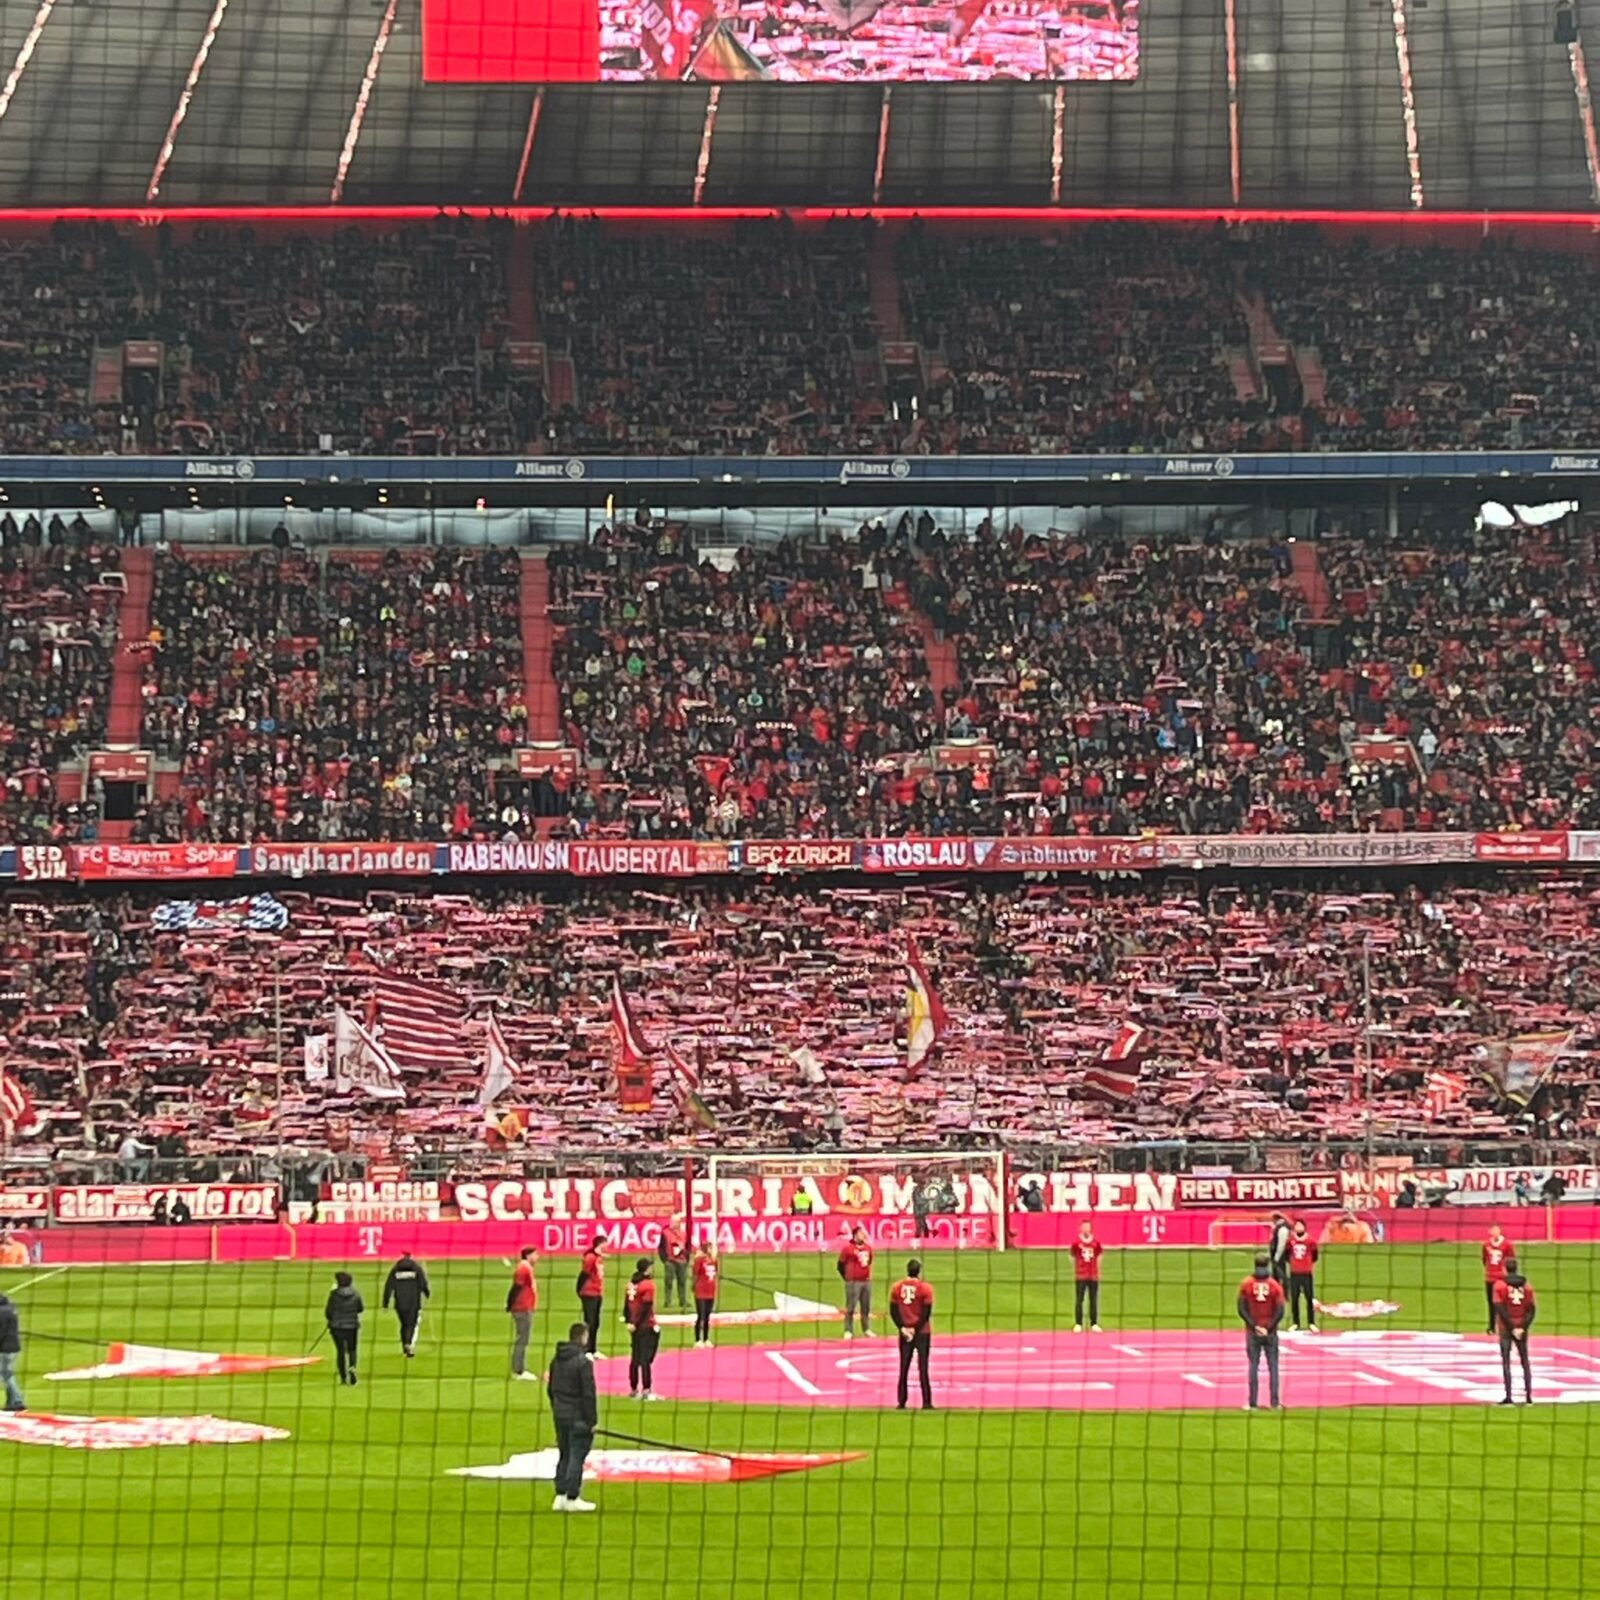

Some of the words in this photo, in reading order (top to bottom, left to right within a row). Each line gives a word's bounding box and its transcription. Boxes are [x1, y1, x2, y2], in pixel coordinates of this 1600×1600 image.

[514, 461, 564, 475] Allianz
[841, 461, 890, 475] Allianz
[79, 847, 103, 864] FC
[108, 846, 170, 867] Bayern
[574, 846, 696, 873] TAUBERTAL
[882, 841, 967, 867] RÖSLAU
[228, 1187, 276, 1216] rot
[543, 1222, 588, 1250] DIE
